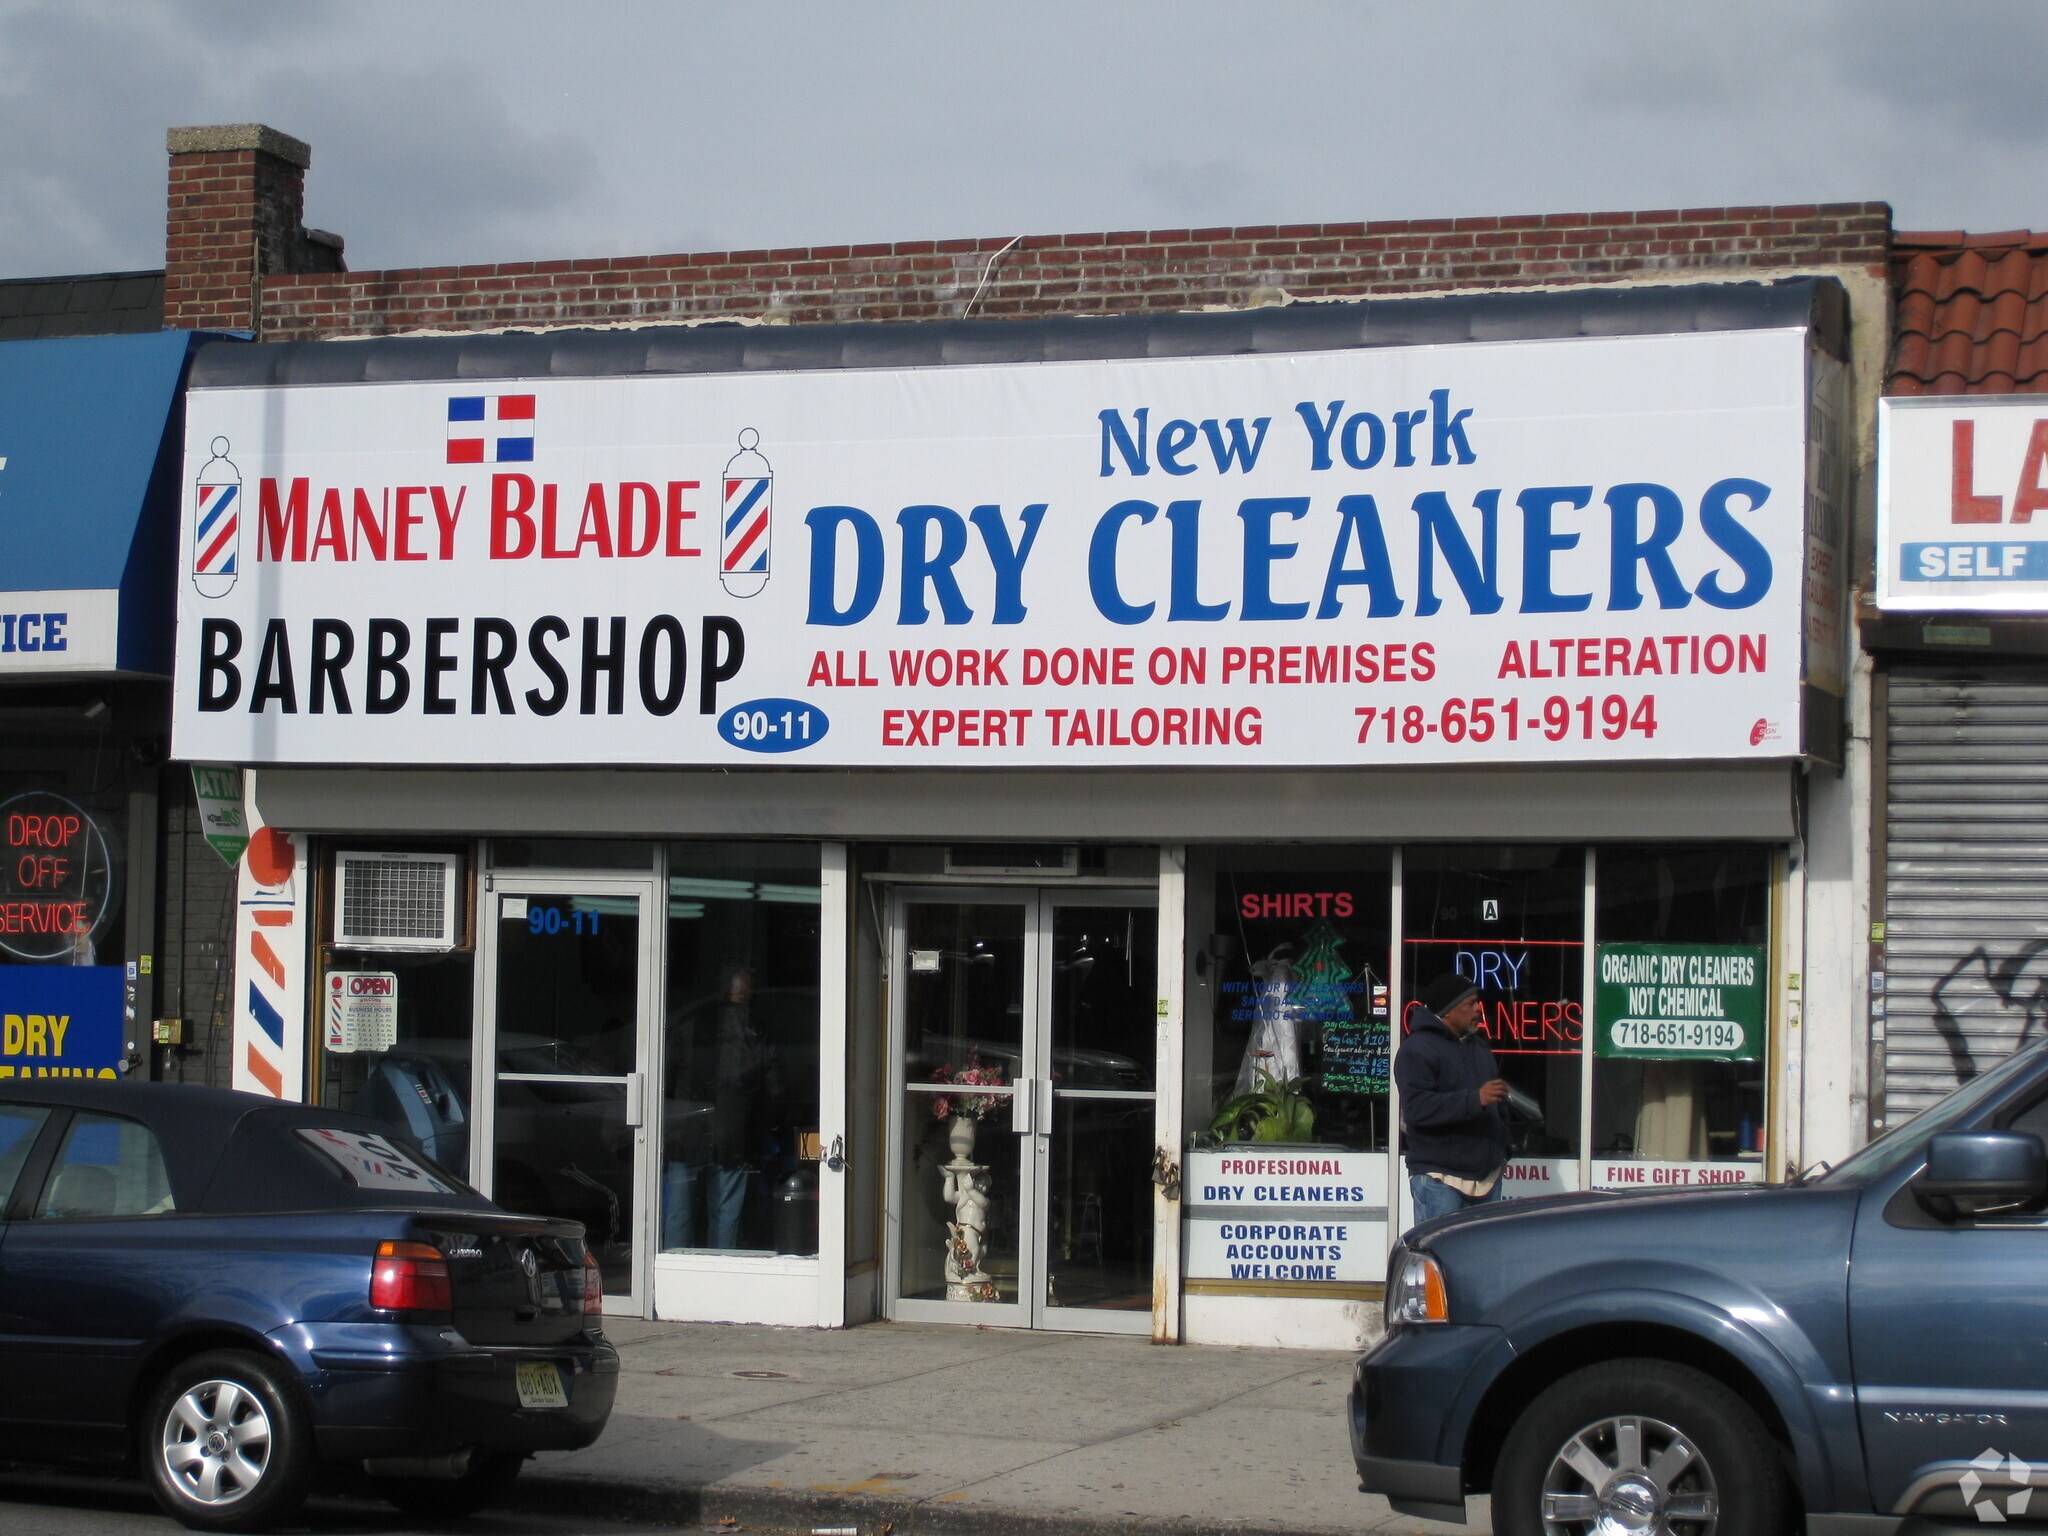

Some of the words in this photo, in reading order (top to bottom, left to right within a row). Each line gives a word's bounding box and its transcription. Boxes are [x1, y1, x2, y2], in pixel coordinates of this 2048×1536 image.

[1098, 407, 1271, 477] New
[1295, 389, 1476, 472] York
[256, 477, 467, 562] MANEY
[489, 473, 701, 560] BLADE
[804, 503, 1049, 626] DRY
[1088, 478, 1773, 625] CLEANERS
[1919, 546, 2027, 578] SELF
[0, 612, 67, 653] ICE
[197, 614, 746, 717] BARBERSHOP
[807, 650, 878, 687] ALL
[890, 648, 1009, 687] WORK
[1022, 647, 1135, 686] DONE
[1148, 646, 1206, 685] ON
[1221, 642, 1436, 684] PREMISES
[1497, 633, 1767, 680] ALTERATION
[733, 709, 811, 740] 90-11
[882, 708, 1033, 747] EXPERT
[1044, 706, 1263, 747] TAILORING
[1353, 694, 1658, 744] 718-651-9194
[199, 769, 240, 798] ATM
[9, 815, 80, 848] DROP
[18, 855, 69, 888] OFF
[0, 903, 91, 934] SERVICE
[529, 906, 600, 936] 90-11
[1241, 892, 1354, 919] SHIRTS
[1485, 901, 1497, 919] A
[1456, 951, 1528, 989] DRY
[1602, 954, 1658, 985] ORGANIC
[1661, 955, 1687, 985] DRY
[1689, 956, 1754, 986] CLEANERS
[350, 977, 391, 995] OPEN
[1222, 982, 1249, 993] WITH
[1628, 987, 1655, 1016] NOT
[1658, 987, 1725, 1017] CHEMICAL
[3, 1014, 70, 1056] DRY
[1403, 1001, 1583, 1041] CANERS
[1620, 1022, 1735, 1047] 718-651-9194
[1221, 1160, 1342, 1175] PROFESIONAL
[1607, 1167, 1645, 1182] FINE
[1652, 1168, 1691, 1185] GIFT
[1698, 1169, 1746, 1184] SHOP
[1203, 1185, 1245, 1201] DRY
[1254, 1186, 1364, 1202] CLEANERS
[1220, 1224, 1348, 1241] CORPORATE
[1226, 1244, 1342, 1260] ACCOUNTS
[1231, 1264, 1337, 1280] WELCOME
